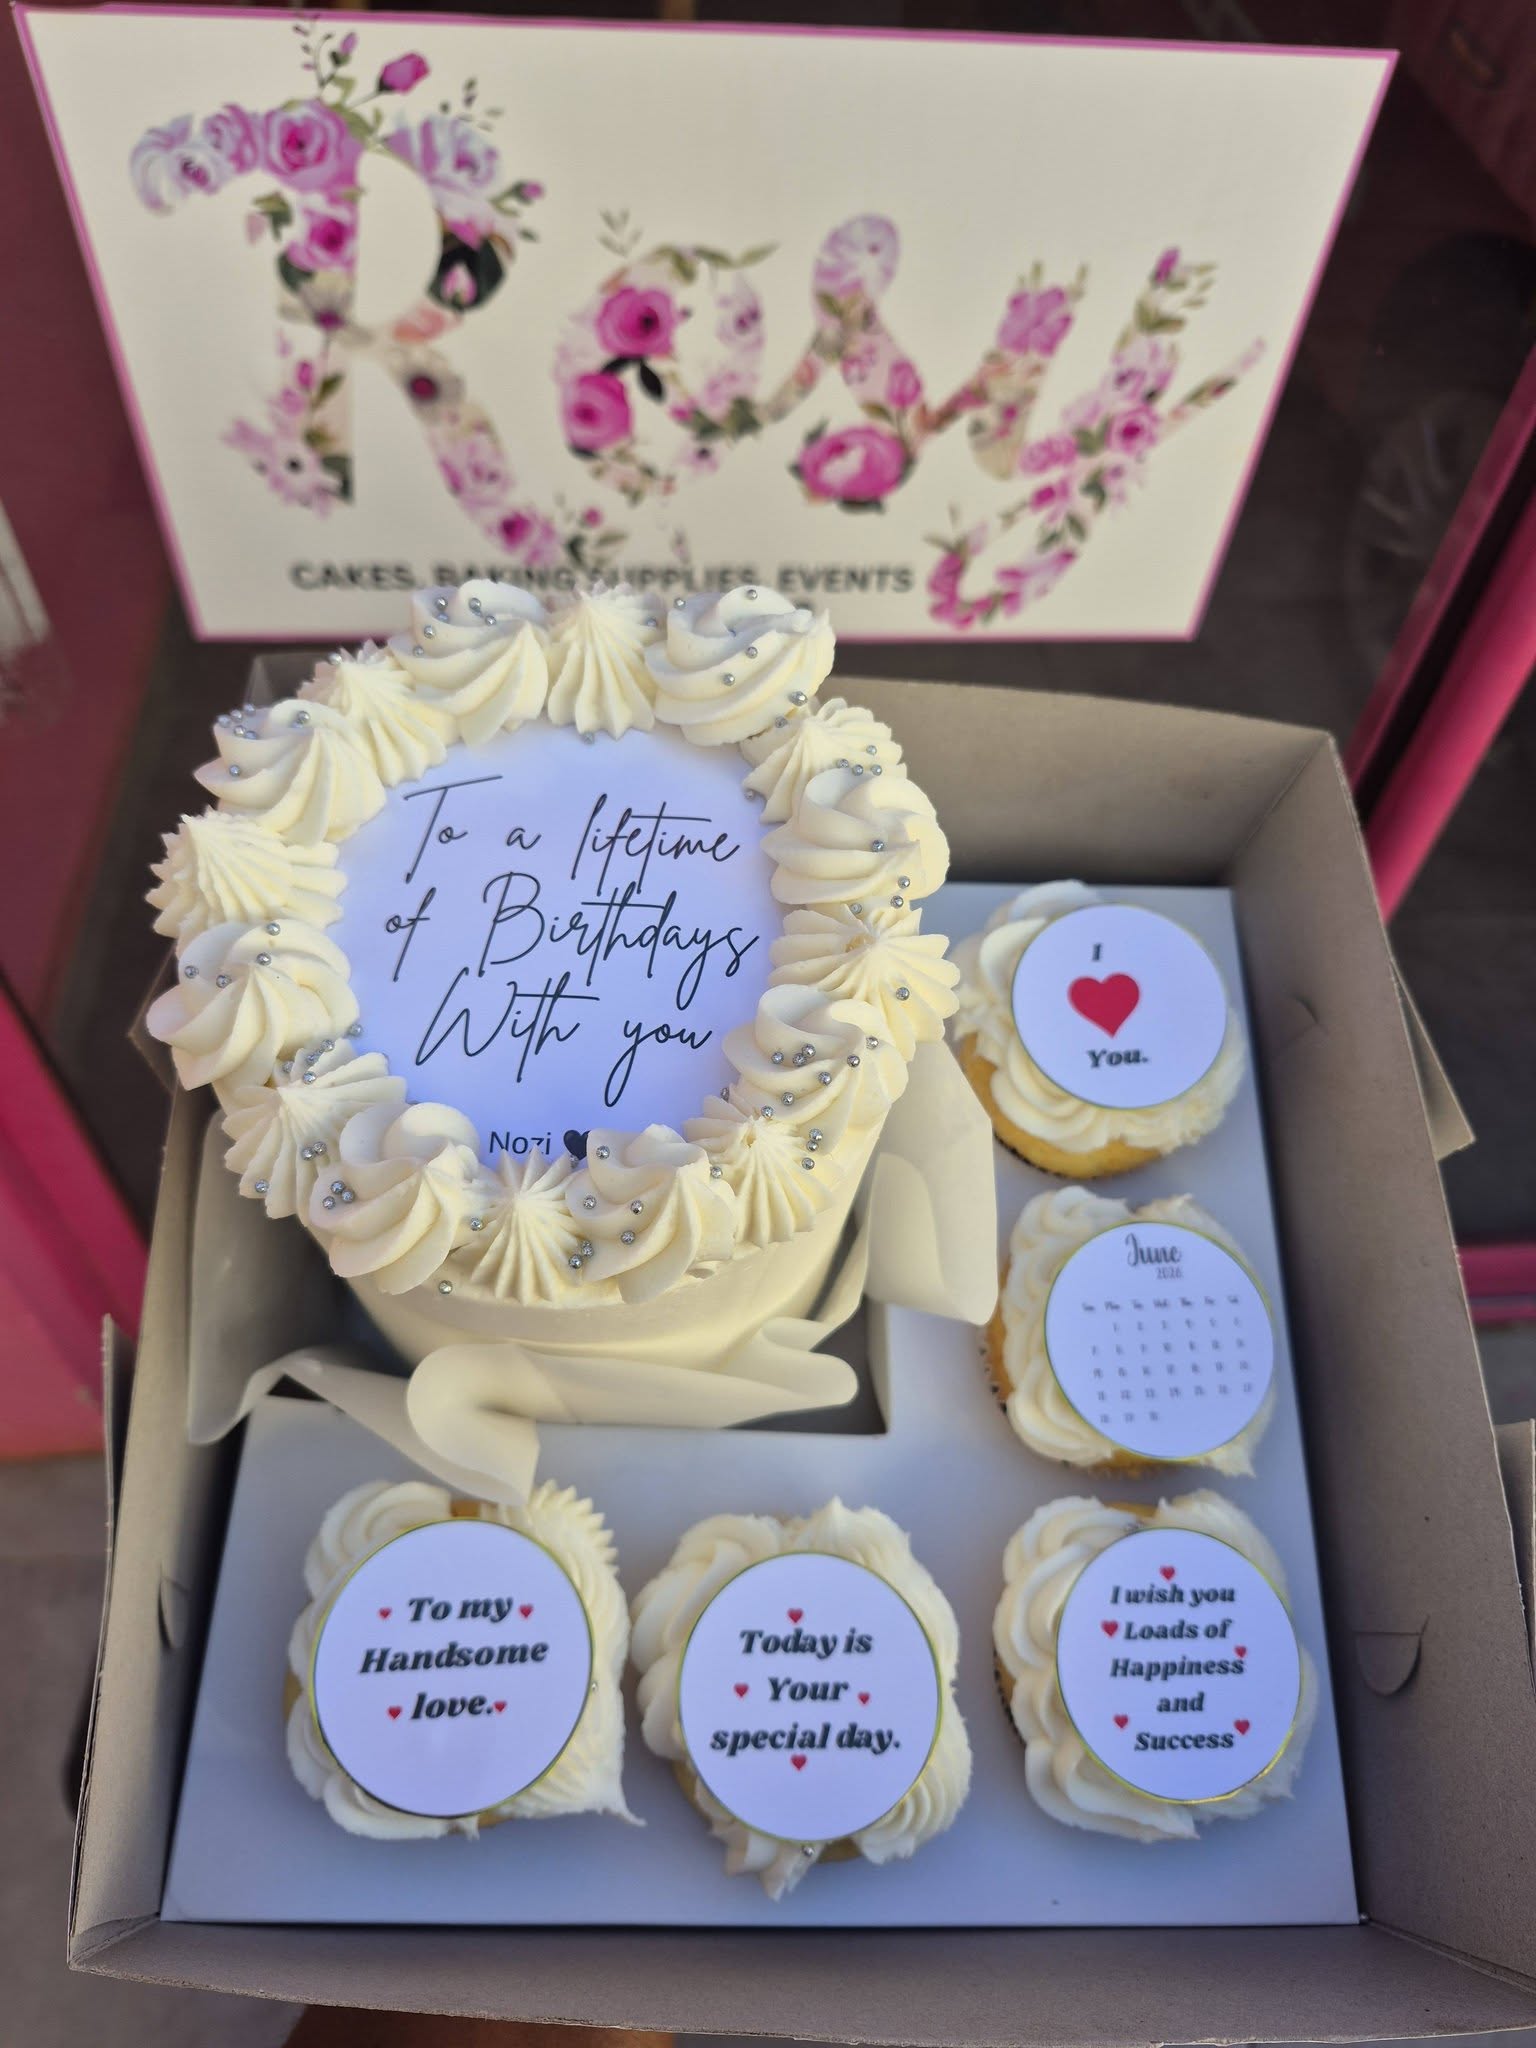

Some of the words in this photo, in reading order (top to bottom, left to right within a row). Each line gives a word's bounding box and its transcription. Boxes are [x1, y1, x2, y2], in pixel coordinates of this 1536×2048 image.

[776, 561, 913, 593] EVENTS
[404, 775, 503, 884] To
[505, 827, 542, 851] a
[570, 793, 741, 896] lifetime
[385, 887, 437, 982] of
[477, 871, 760, 1011] Birthdays
[1091, 942, 1103, 963] I
[415, 966, 601, 1084] With
[604, 1017, 713, 1108] you
[1088, 1049, 1149, 1069] You.
[1125, 1233, 1182, 1267] June
[1110, 1585, 1121, 1605] I
[1125, 1583, 1185, 1605] wish
[1189, 1588, 1236, 1608] you
[408, 1597, 453, 1623] To
[457, 1597, 514, 1624] my
[1124, 1619, 1199, 1641] Loads
[1203, 1618, 1233, 1639] of
[359, 1641, 549, 1674] Handsome
[739, 1627, 838, 1661] Today
[843, 1627, 873, 1654] is
[1110, 1655, 1247, 1682] Happiness
[768, 1677, 850, 1702] Your
[1156, 1691, 1205, 1713] and
[410, 1692, 494, 1720] love.
[709, 1722, 831, 1757] special
[835, 1722, 901, 1756] day.
[1134, 1732, 1235, 1751] Success
